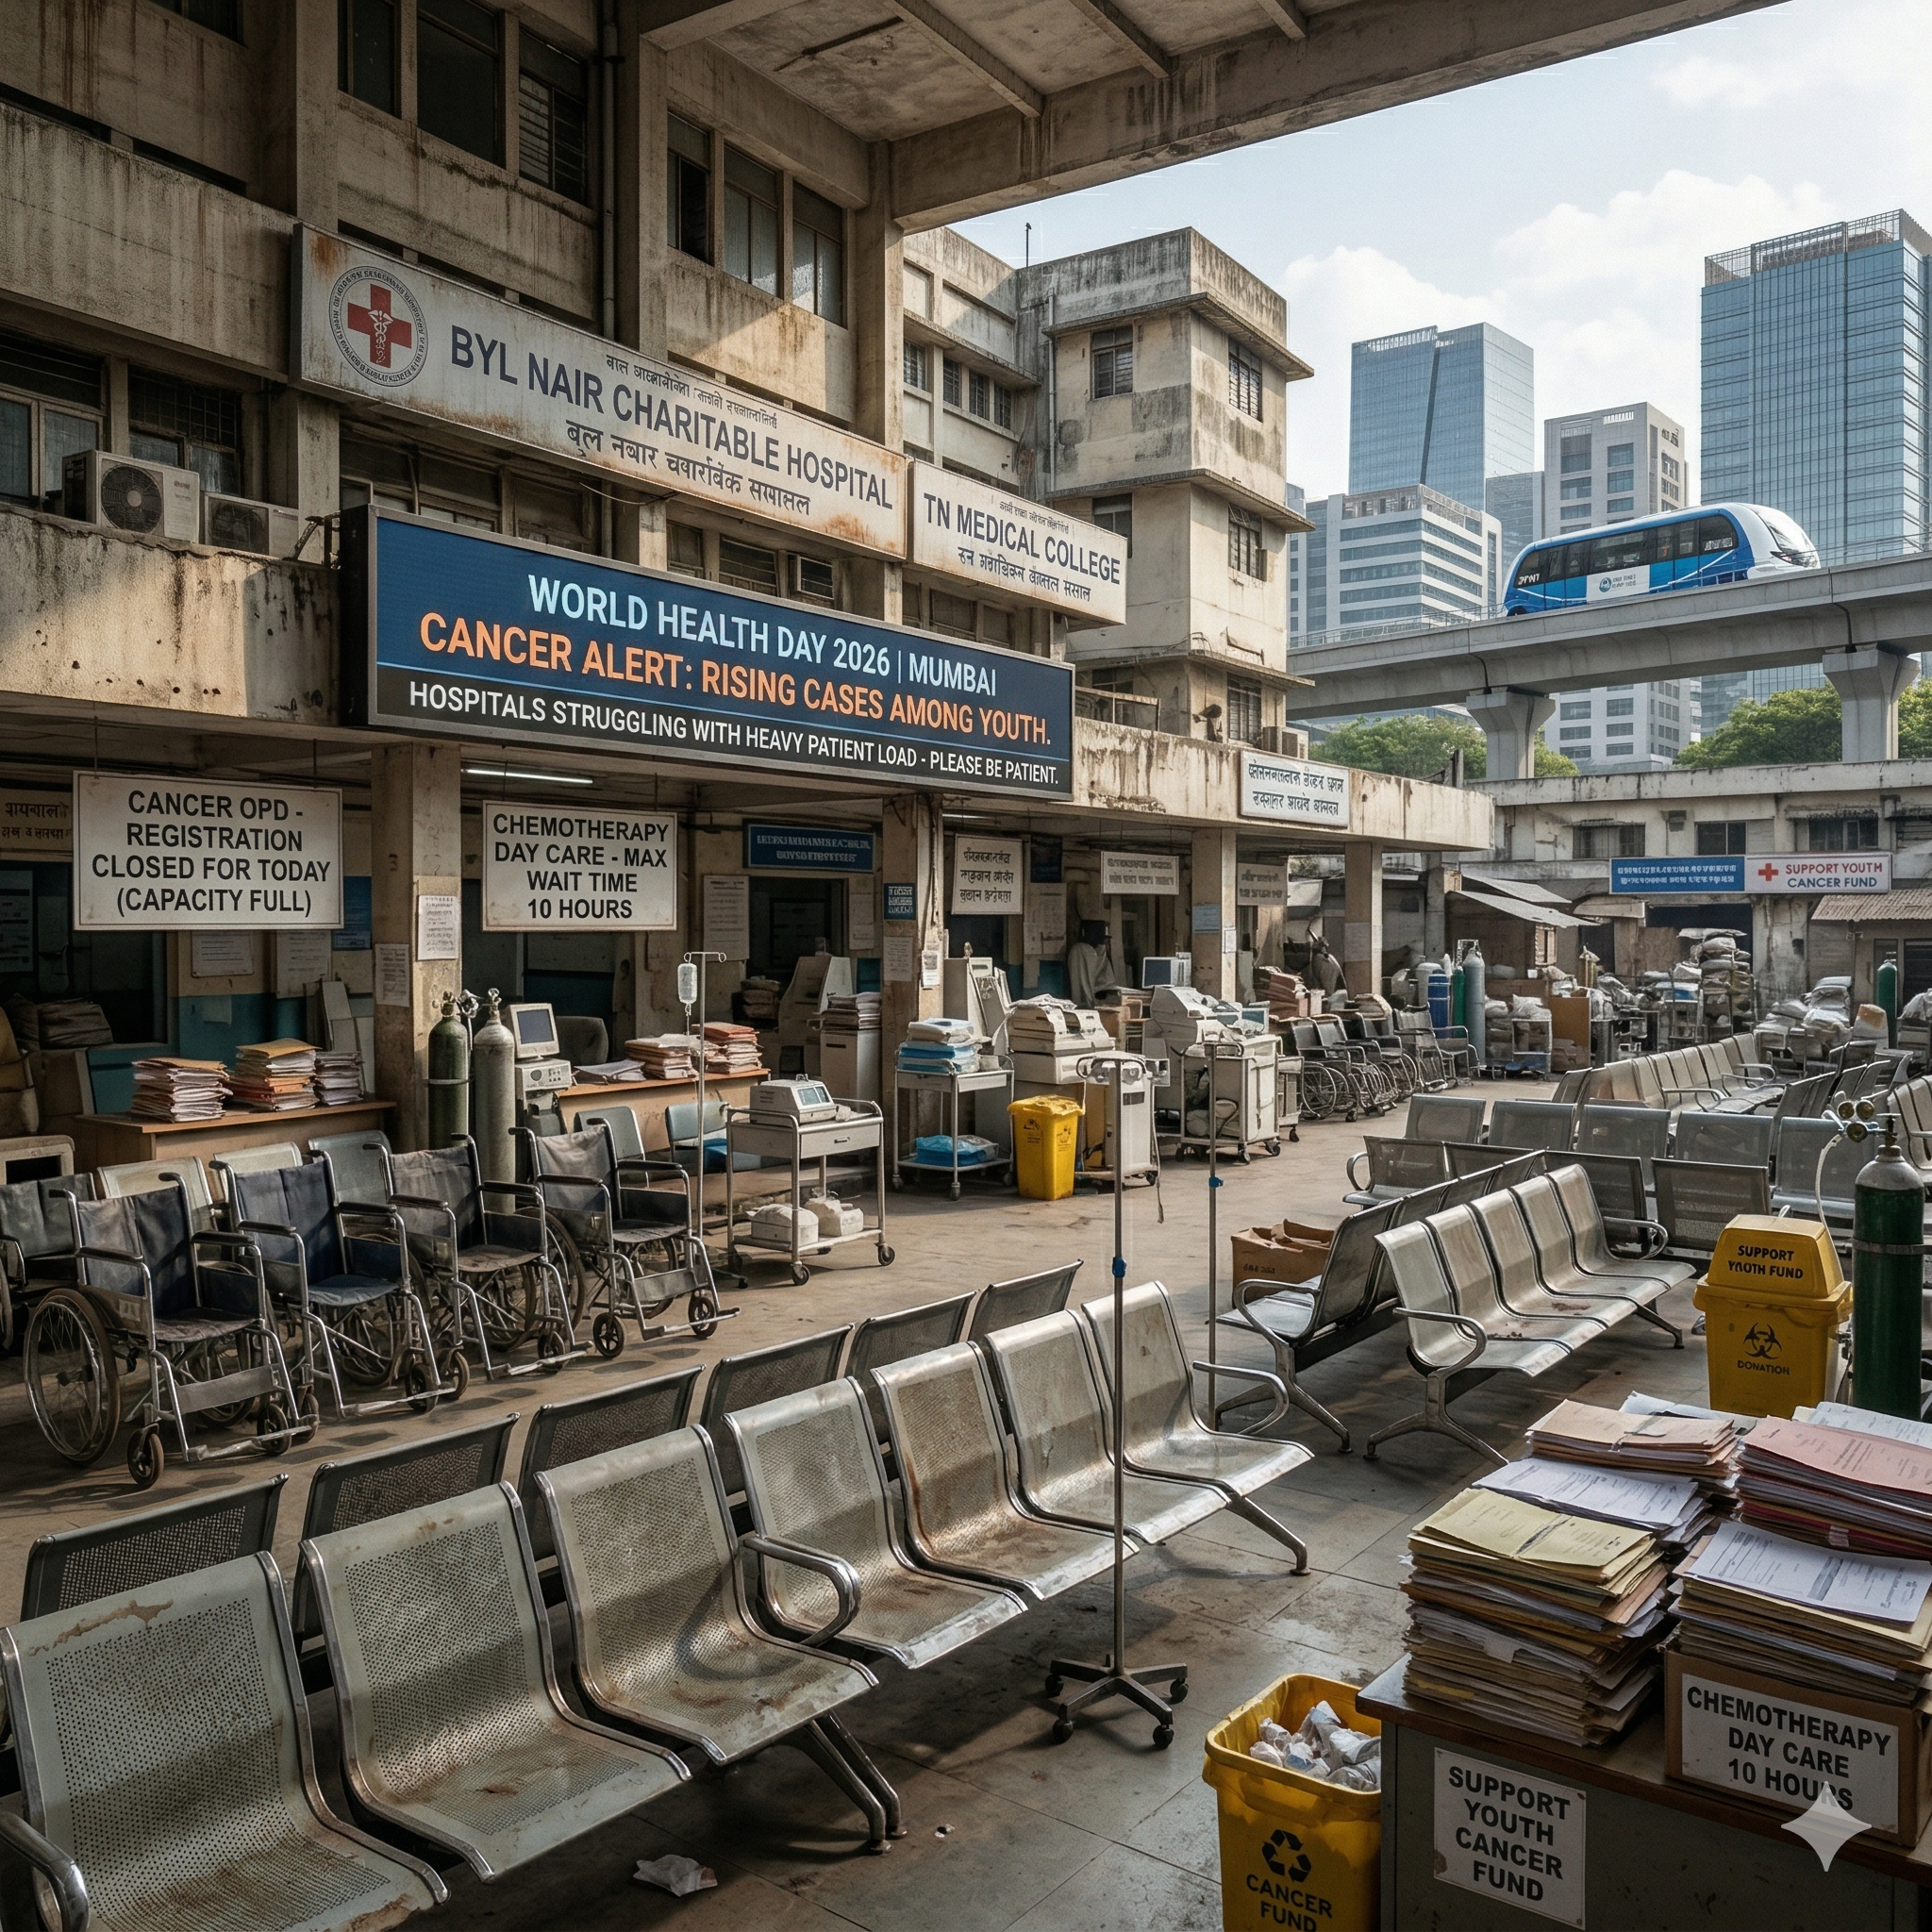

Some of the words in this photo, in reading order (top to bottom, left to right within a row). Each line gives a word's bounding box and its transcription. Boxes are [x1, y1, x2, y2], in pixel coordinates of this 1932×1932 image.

[452, 325, 518, 386] BYL
[528, 352, 604, 414] NAIR
[613, 384, 779, 472] CHARITABLE
[787, 444, 892, 509] HOSPITAL
[924, 492, 950, 529] TN
[958, 505, 1040, 558] MEDICAL
[1045, 537, 1120, 585] COLLEGE
[528, 575, 648, 630] WORLD
[658, 601, 769, 654] HEALTH
[777, 625, 827, 664] DAY
[833, 638, 891, 676] 2026
[908, 653, 996, 696] MUMBAI
[420, 612, 572, 673] CANCER
[582, 640, 692, 691] ALERT:
[702, 659, 796, 706] RISING
[804, 678, 884, 720] CASES
[890, 693, 974, 734] AMONG
[978, 708, 1052, 745] YOUTH.
[409, 681, 546, 722] HOSPITALS
[552, 700, 687, 739] STRUGGLING
[691, 718, 741, 746] WITH
[746, 725, 805, 754] HEAVY
[808, 734, 876, 762] PATIENT
[877, 743, 917, 767] LOAD
[930, 750, 983, 775] PLEASE
[986, 758, 1003, 778] BE
[1005, 761, 1058, 785] PATIENT.
[128, 791, 233, 819] CANCER
[240, 797, 290, 821] OPD
[126, 823, 303, 852] REGISTRATION
[492, 813, 669, 842] CHEMOTHERAPY
[92, 854, 195, 879] CLOSED
[203, 858, 251, 881] FOR
[258, 859, 330, 883] TODAY
[494, 841, 540, 862] DAY
[545, 844, 605, 866] CARE
[624, 848, 668, 868] MAX
[1785, 863, 1839, 874] SUPPORT
[526, 870, 582, 891] WAIT
[588, 873, 638, 892] TIME
[1787, 877, 1840, 888] CANCER
[1844, 877, 1877, 888] FUND
[117, 888, 243, 917] (CAPACITY
[250, 890, 311, 918] FULL)
[527, 898, 552, 919] 10
[559, 899, 633, 919] HOURS
[1738, 1244, 1794, 1261] SUPPORT
[1769, 1265, 1804, 1279] FUND
[1737, 1359, 1790, 1375] DONATION
[1687, 1686, 1891, 1757] CHEMOTHERAPY
[1728, 1727, 1774, 1756] DAY
[1783, 1741, 1849, 1778] CARE
[1448, 1766, 1570, 1820] SUPPORT
[1728, 1758, 1756, 1784] 10
[1765, 1767, 1853, 1810] HOURS
[1463, 1798, 1554, 1846] YOUTH
[1456, 1826, 1563, 1880] CANCER
[1246, 1874, 1332, 1919] CANCER
[1473, 1859, 1543, 1903] FUND
[1260, 1900, 1317, 1932] FUND
